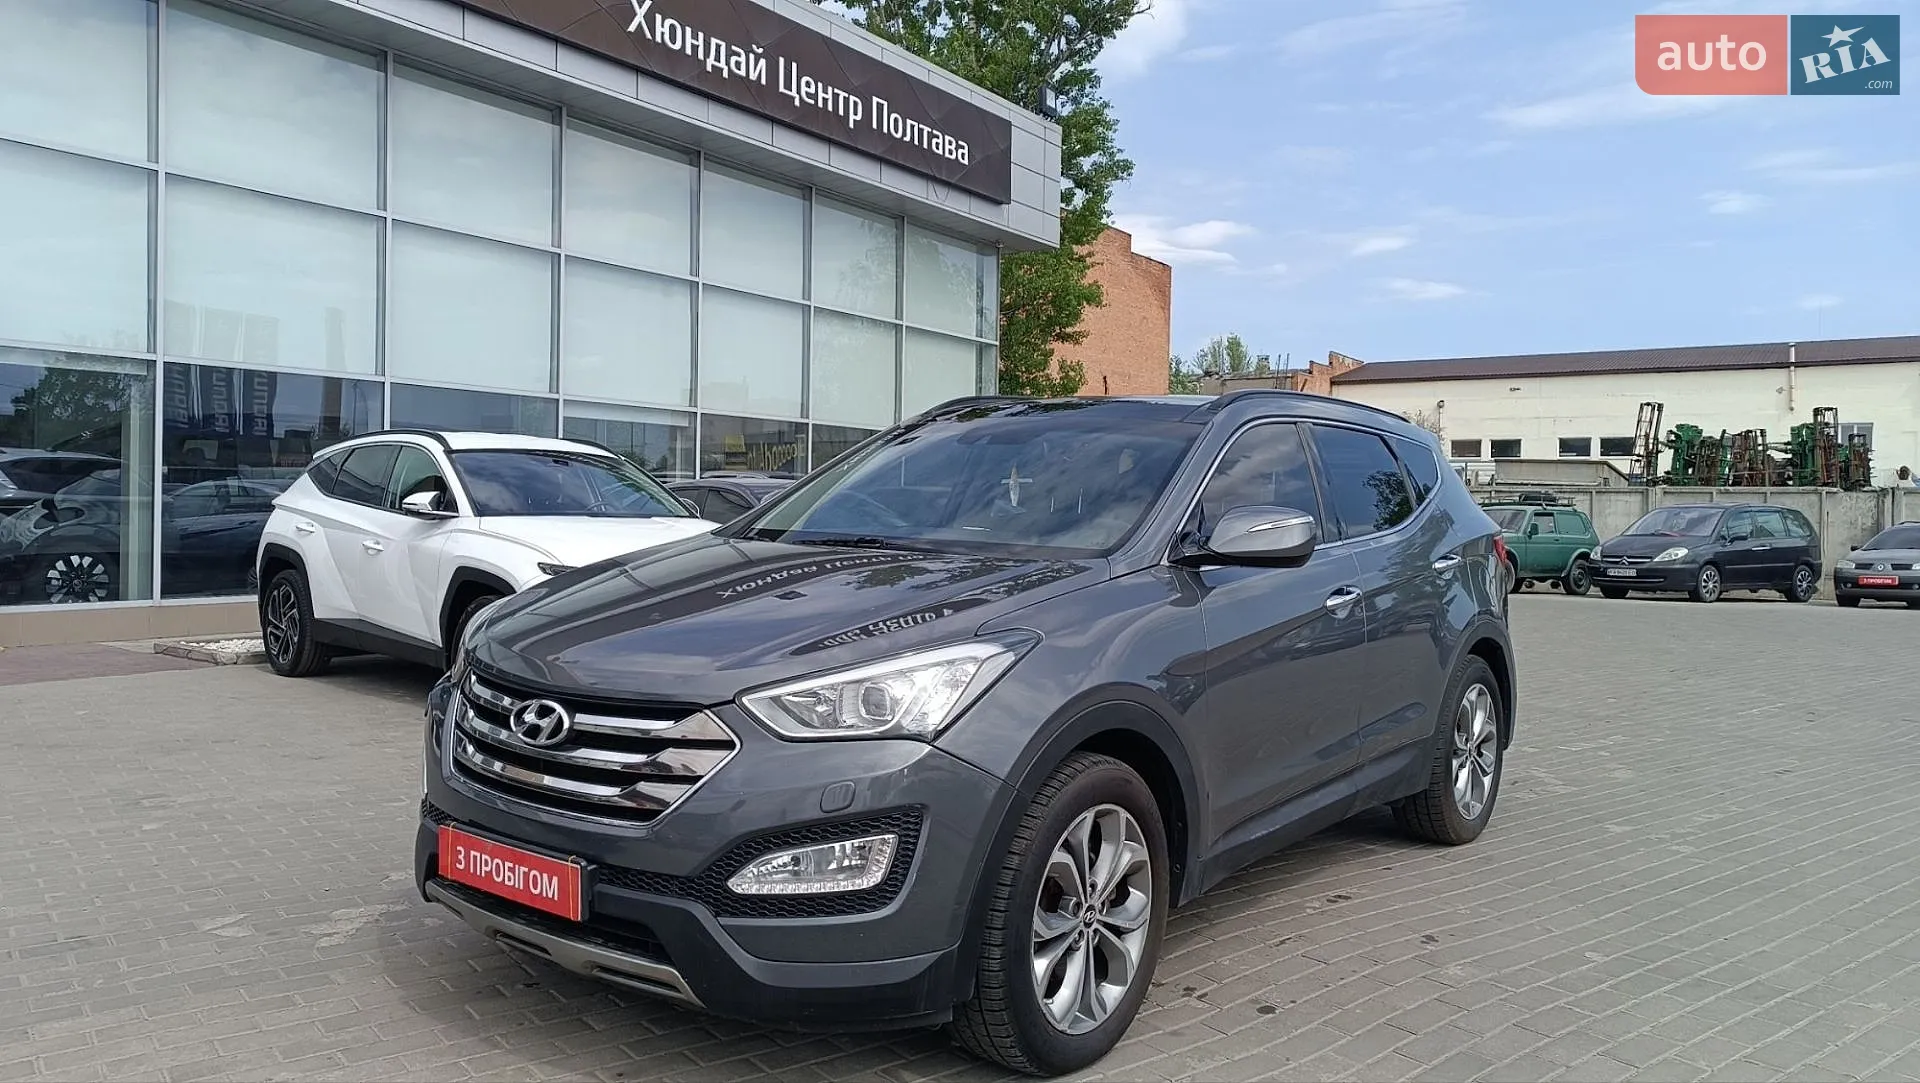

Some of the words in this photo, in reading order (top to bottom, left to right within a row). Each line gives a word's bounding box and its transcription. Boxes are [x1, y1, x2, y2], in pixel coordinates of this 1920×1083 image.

[627, 0, 767, 86] Хюндай
[778, 55, 863, 129] Центр
[871, 95, 970, 166] Полтава
[469, 850, 559, 901] ПРОБІГОМ
